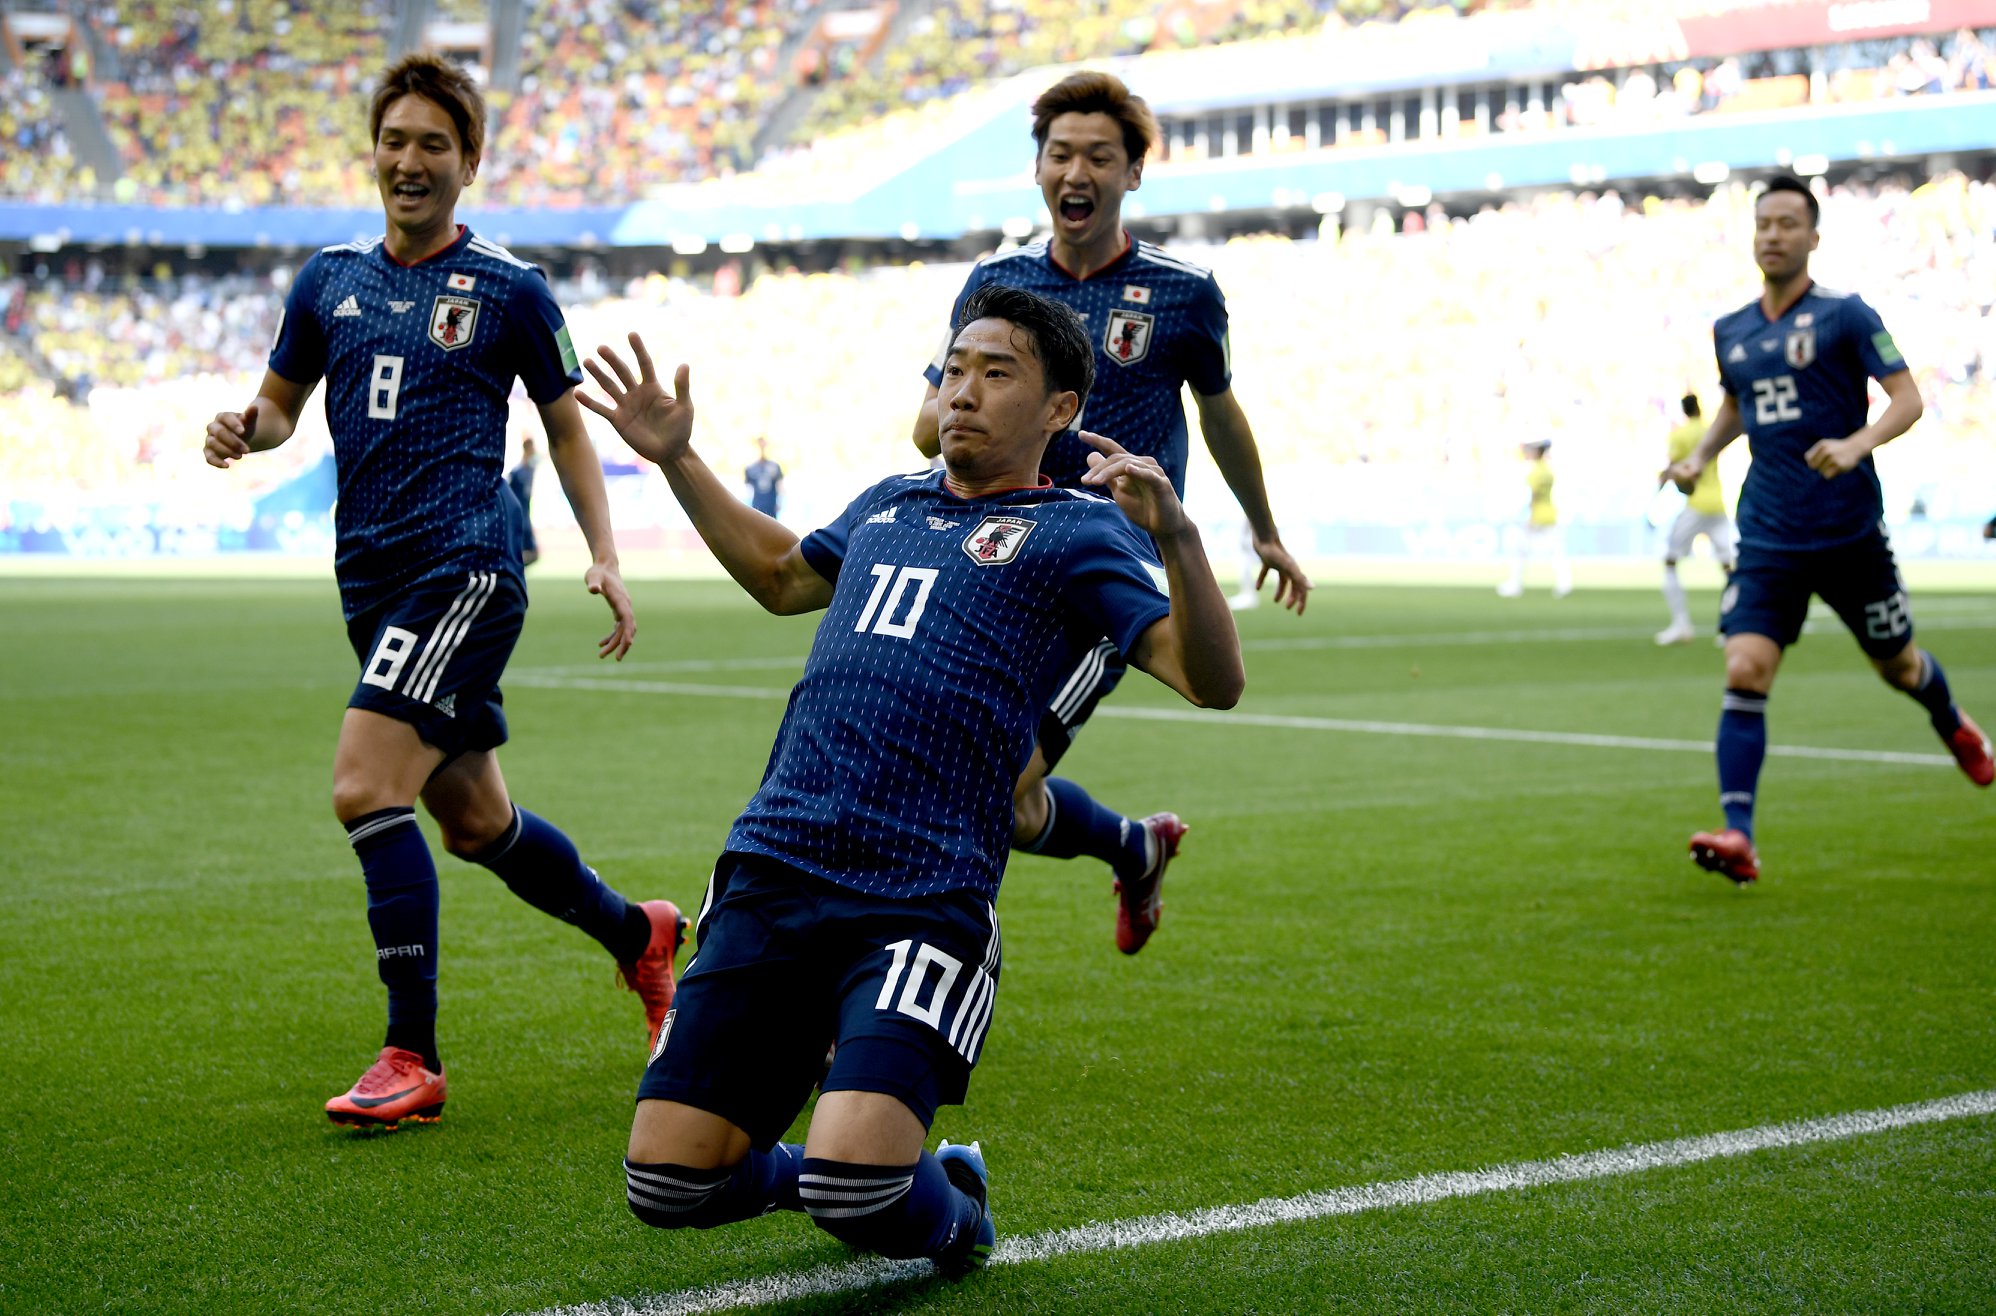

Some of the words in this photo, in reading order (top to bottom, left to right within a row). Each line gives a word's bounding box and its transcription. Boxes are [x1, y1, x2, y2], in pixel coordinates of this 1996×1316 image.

[368, 355, 404, 420] 8
[1752, 375, 1802, 425] 22
[974, 544, 998, 559] JFA
[854, 563, 939, 640] 10
[1864, 591, 1908, 639] 22
[362, 625, 419, 691] 8
[376, 944, 424, 960] APAN
[875, 939, 963, 1031] 10
